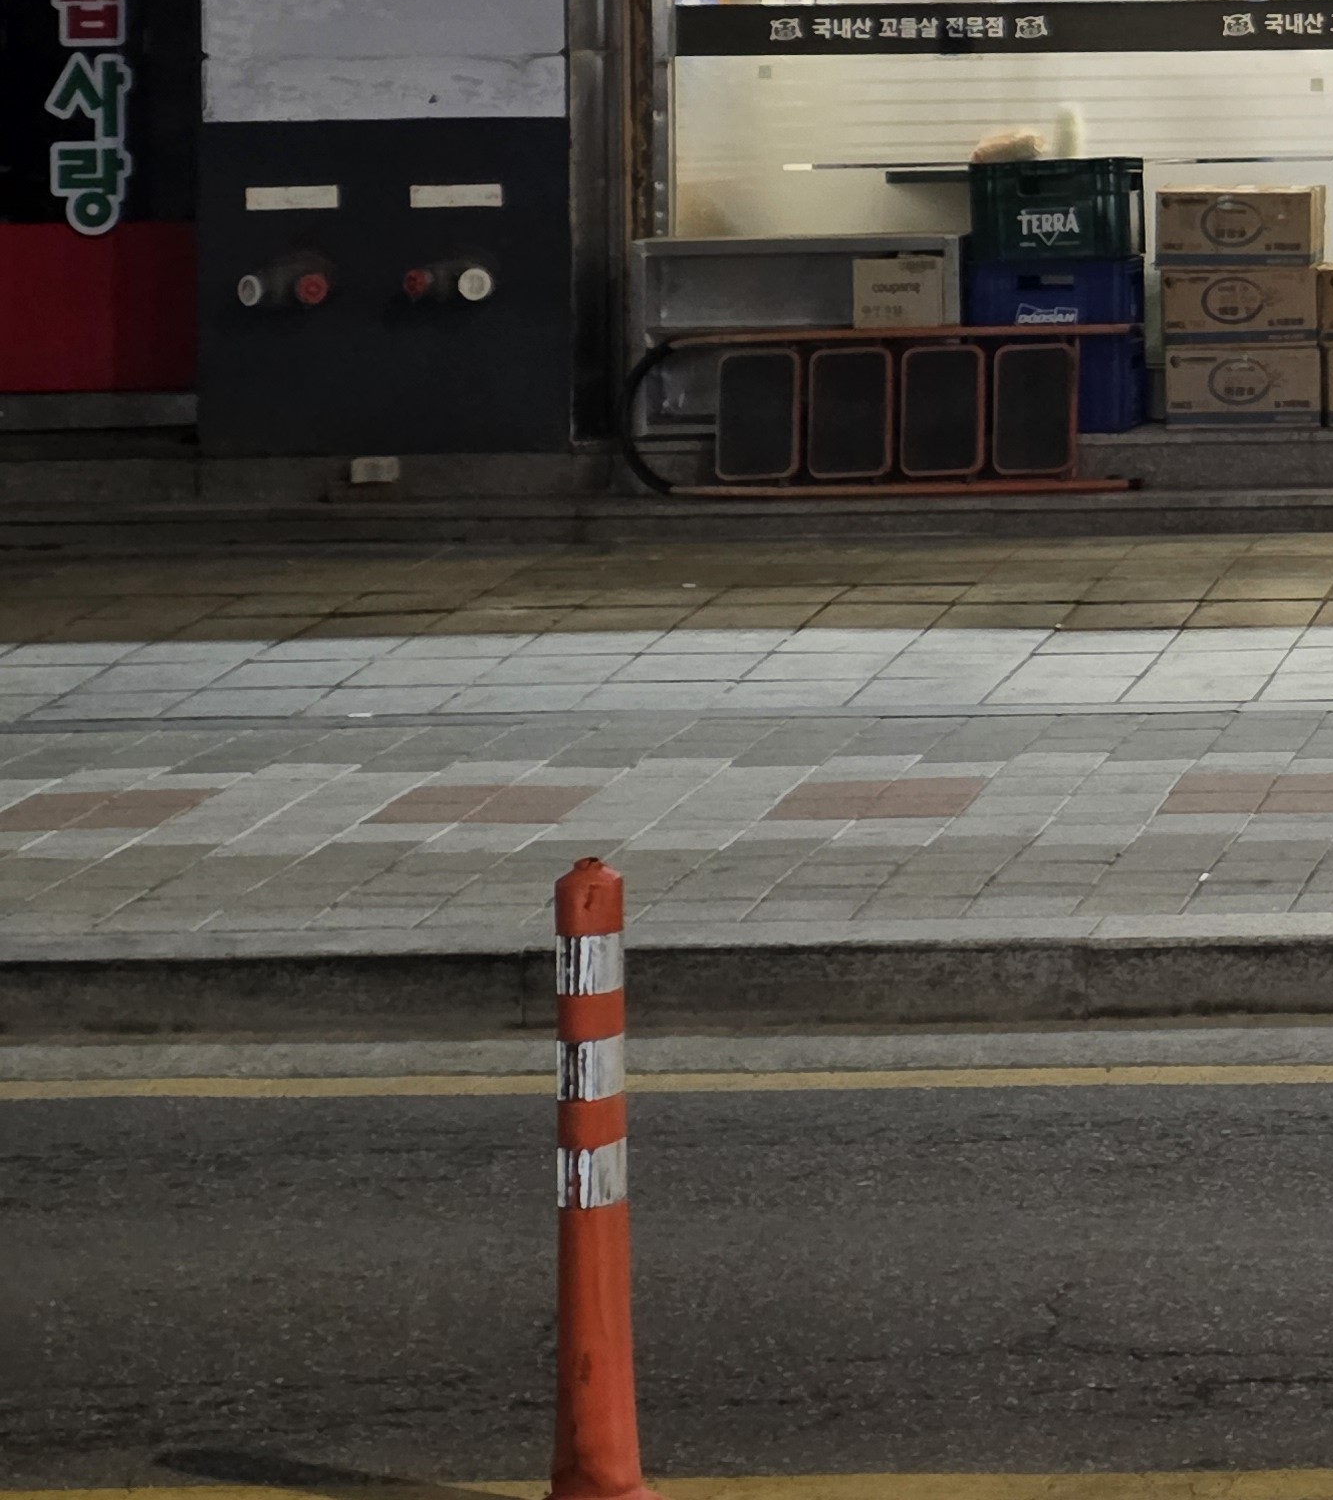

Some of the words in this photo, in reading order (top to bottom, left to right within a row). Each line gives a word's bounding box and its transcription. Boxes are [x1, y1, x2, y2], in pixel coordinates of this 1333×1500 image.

[812, 17, 872, 39] 국내산
[878, 17, 938, 38] 꼬들살
[946, 16, 1004, 38] 전문점
[1264, 12, 1324, 34] 국내산
[1017, 207, 1080, 235] TERRA
